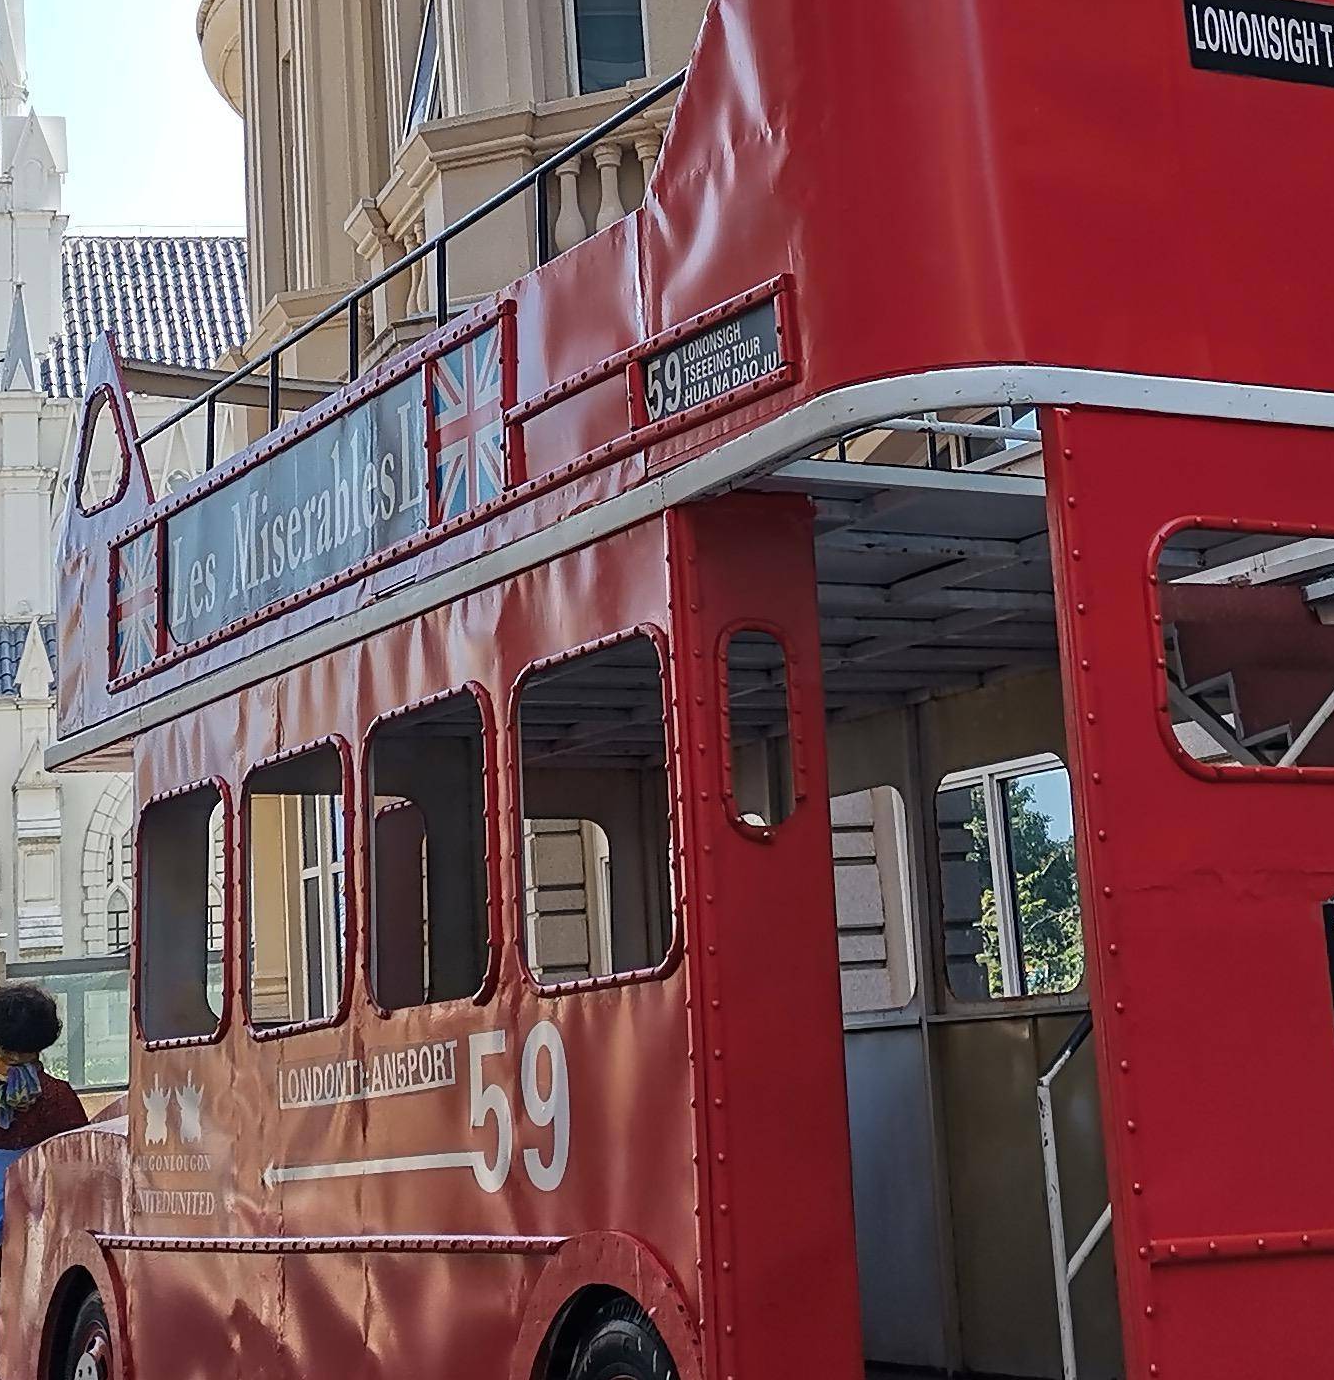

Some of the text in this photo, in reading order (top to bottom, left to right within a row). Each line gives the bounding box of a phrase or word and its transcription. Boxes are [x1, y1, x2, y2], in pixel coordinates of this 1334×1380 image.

[1190, 3, 1321, 67] LONONSIGH
[683, 380, 710, 408] HUA
[712, 371, 730, 395] NA
[732, 359, 759, 387] DAO
[732, 336, 761, 365] TOUR
[646, 351, 681, 421] 59
[171, 536, 216, 628] Les
[468, 1020, 571, 1193] 59
